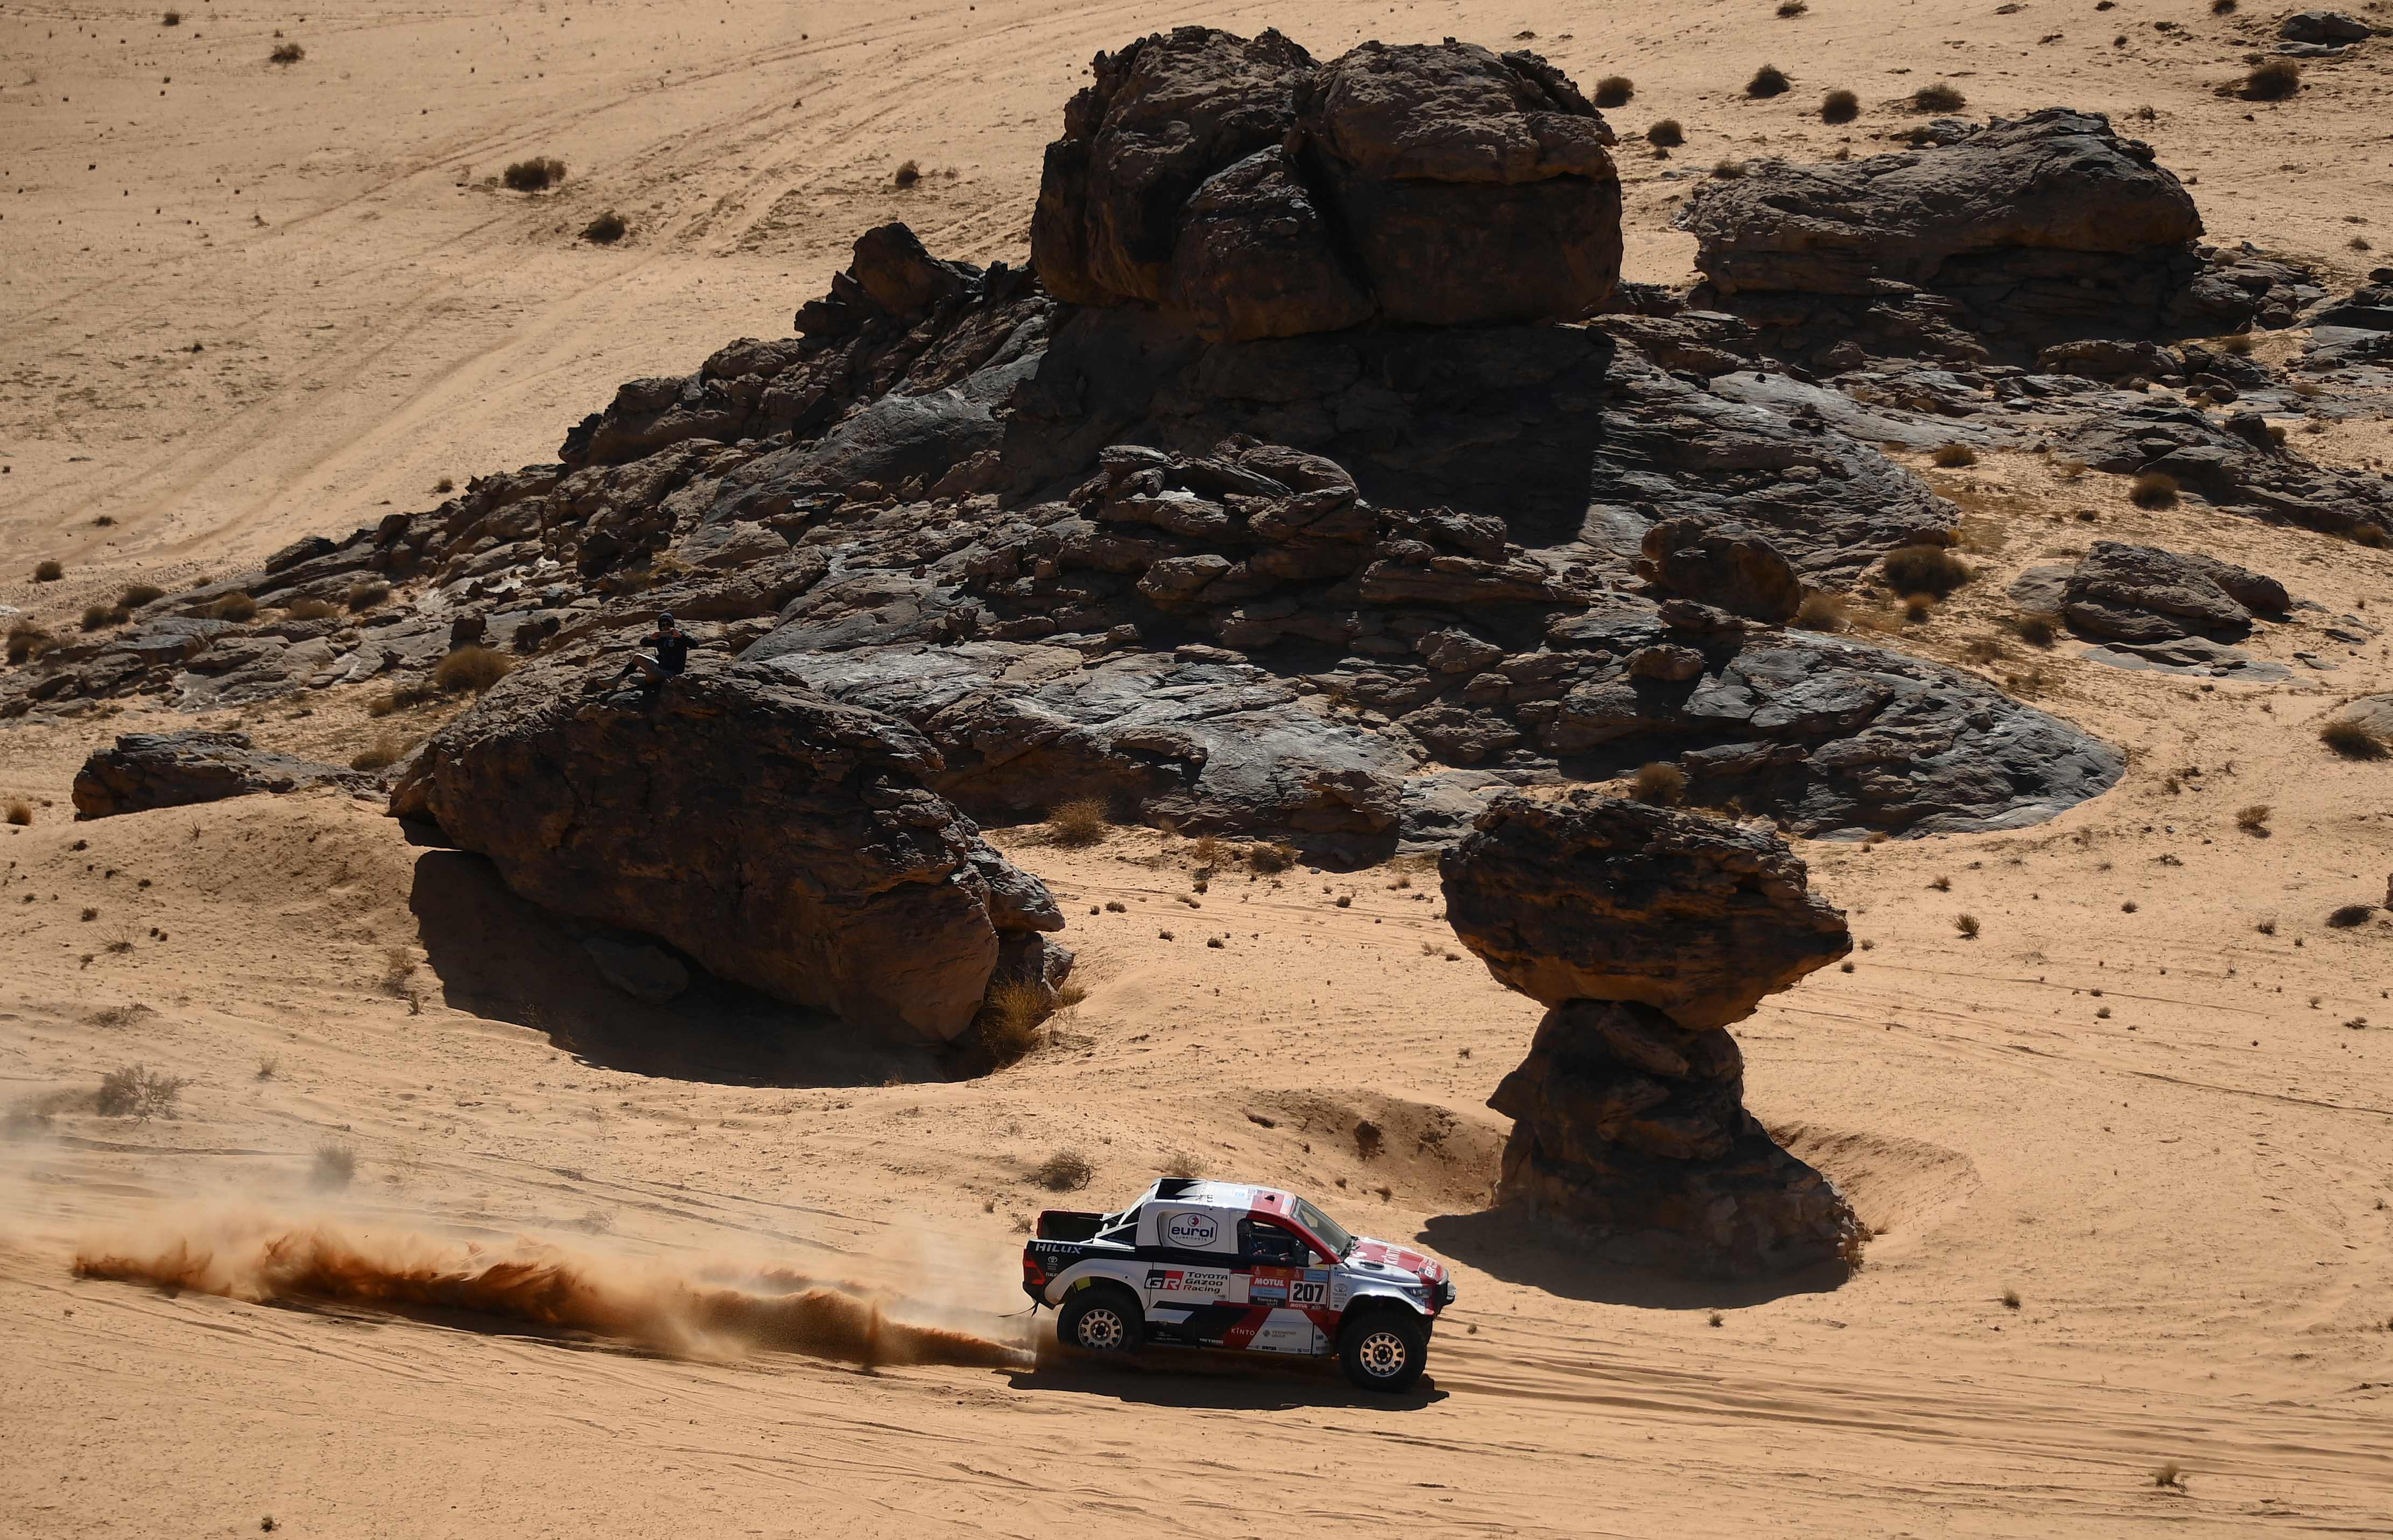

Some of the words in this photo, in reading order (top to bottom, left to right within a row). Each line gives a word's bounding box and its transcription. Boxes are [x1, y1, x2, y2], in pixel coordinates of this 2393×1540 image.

[1171, 1227, 1214, 1237] eurol
[1035, 1243, 1082, 1254] HILUX
[1187, 1271, 1228, 1280] TOYOTA
[1145, 1277, 1180, 1289] GR
[1254, 1278, 1284, 1286] MOTUL
[1184, 1285, 1220, 1293] Racing
[1293, 1283, 1324, 1302] 207
